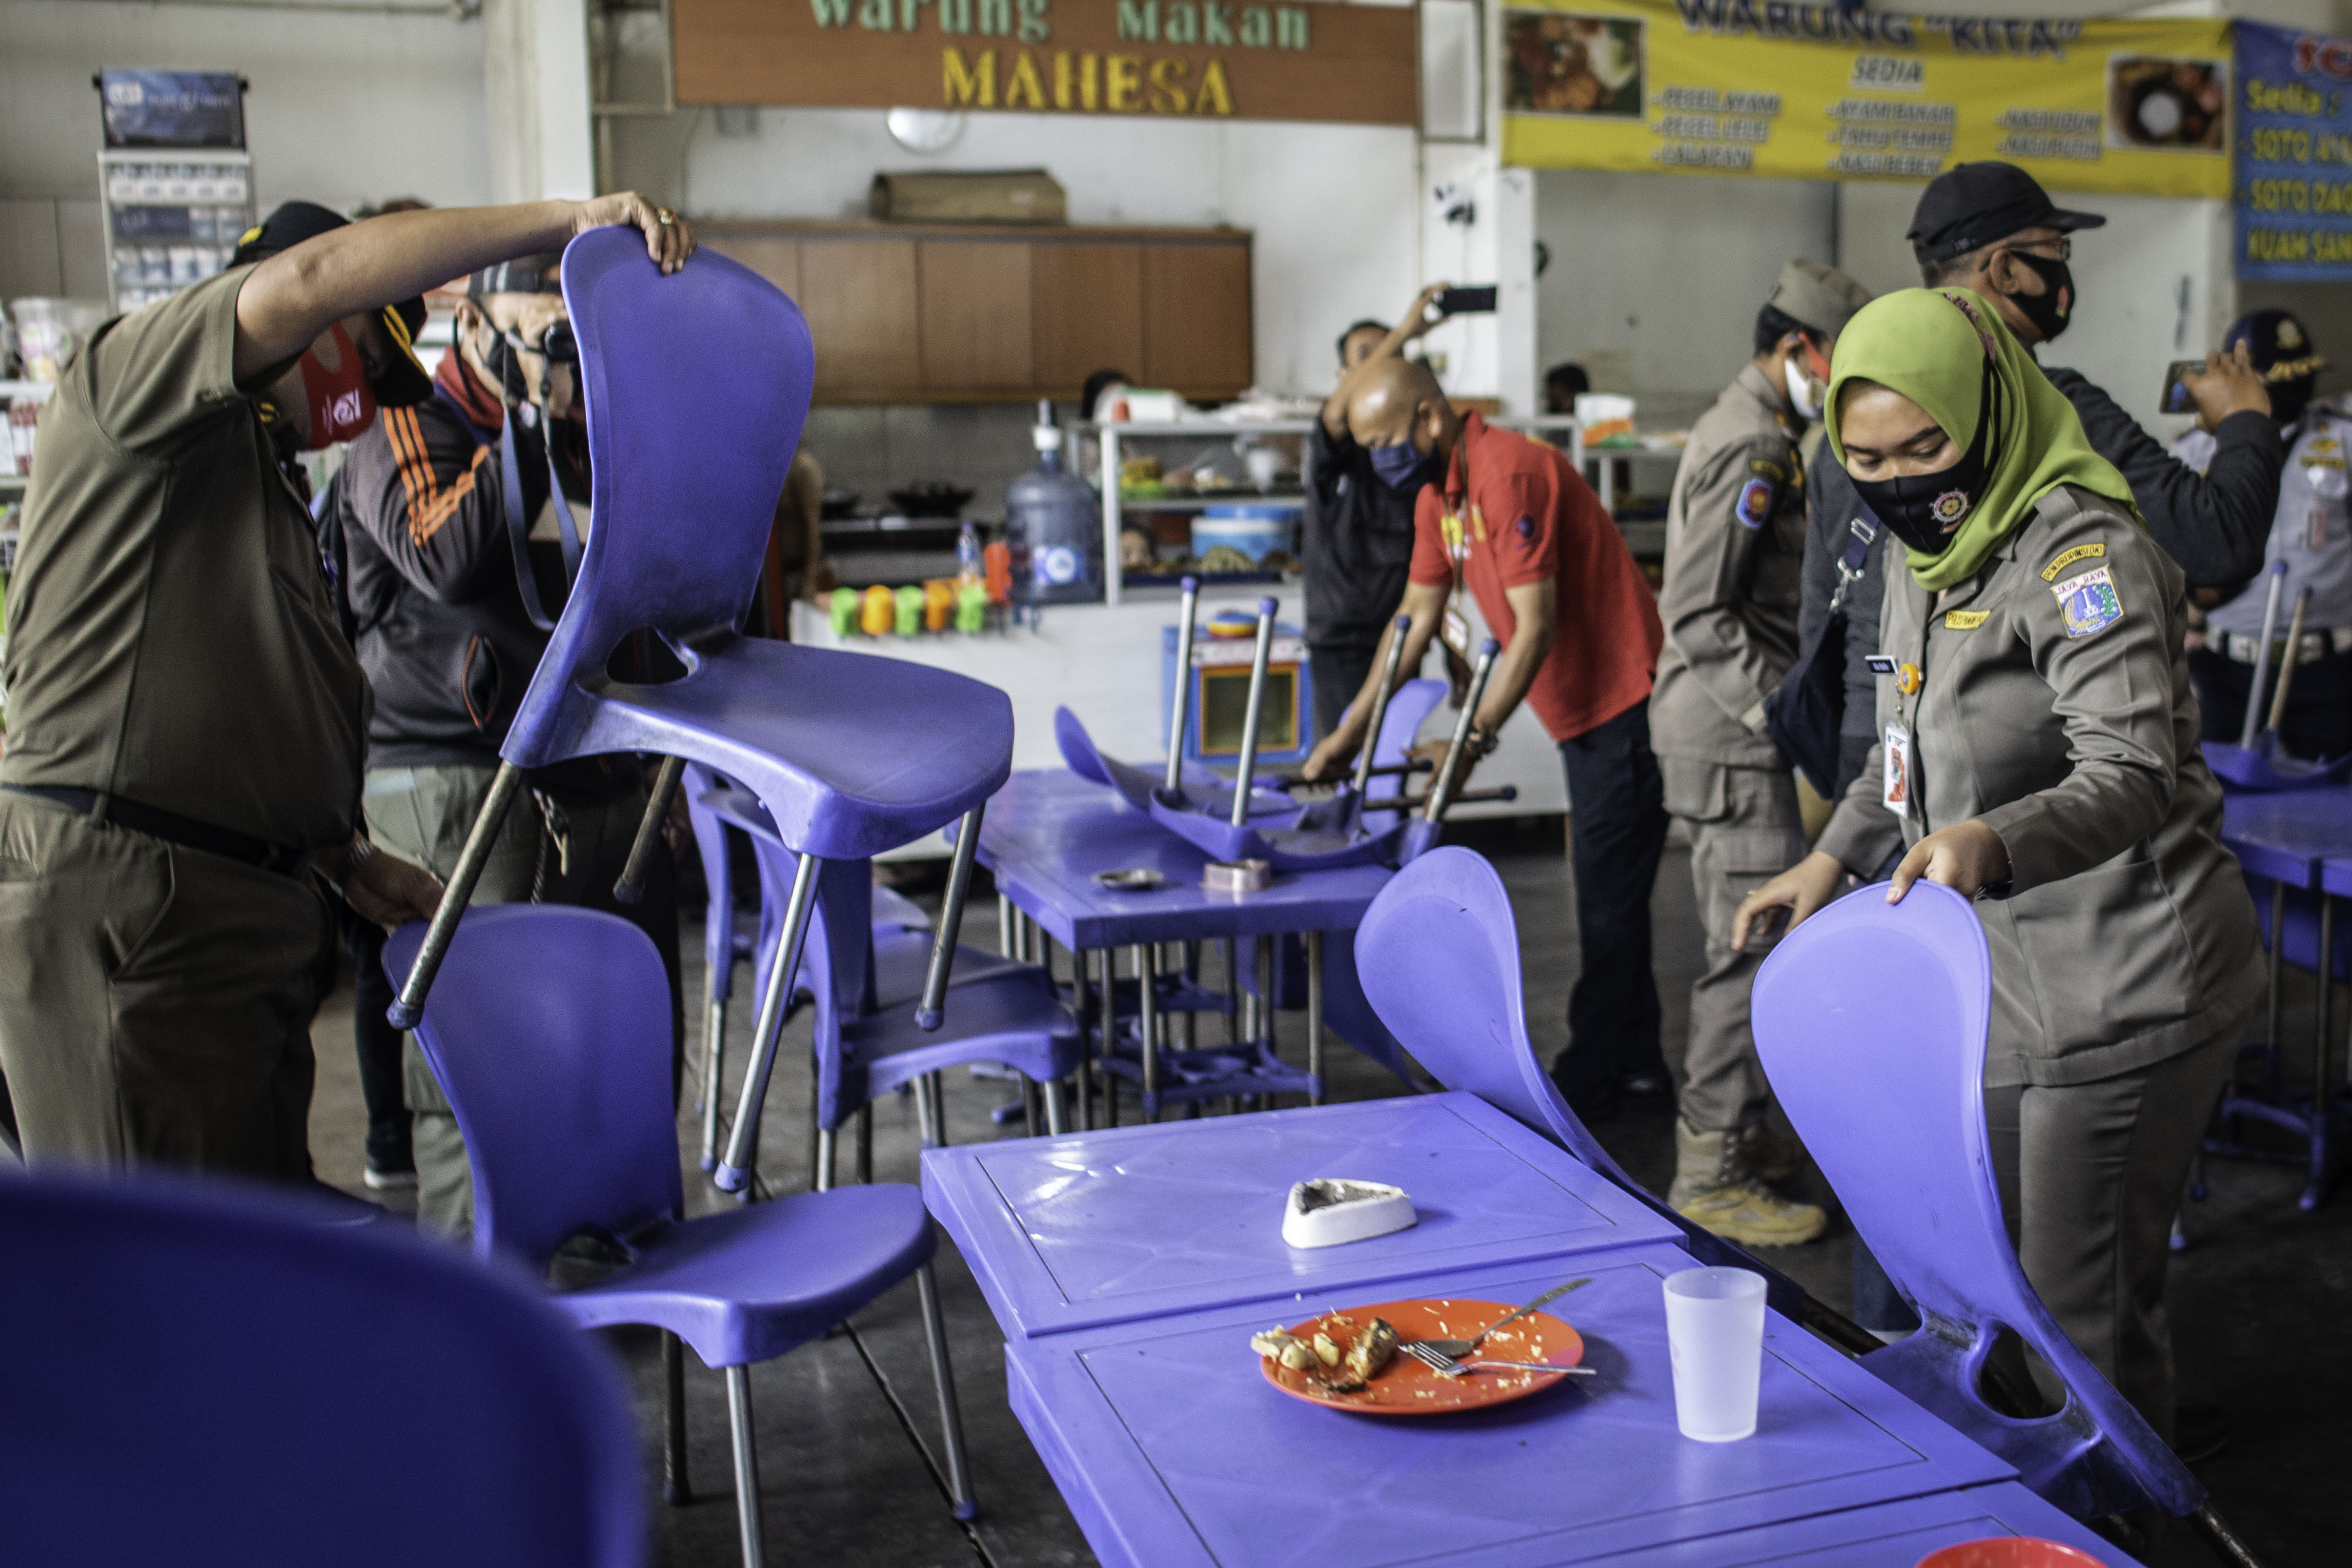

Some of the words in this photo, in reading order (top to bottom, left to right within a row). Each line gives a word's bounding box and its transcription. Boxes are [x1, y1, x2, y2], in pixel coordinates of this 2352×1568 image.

[811, 0, 1051, 44] Warung
[1118, 0, 1309, 49] Makan
[943, 47, 1232, 114] MAHESA
[2251, 127, 2310, 163] SOTO
[2251, 179, 2308, 213] SOTO
[2057, 581, 2078, 595] JAYA
[2082, 570, 2107, 584] RAYA
